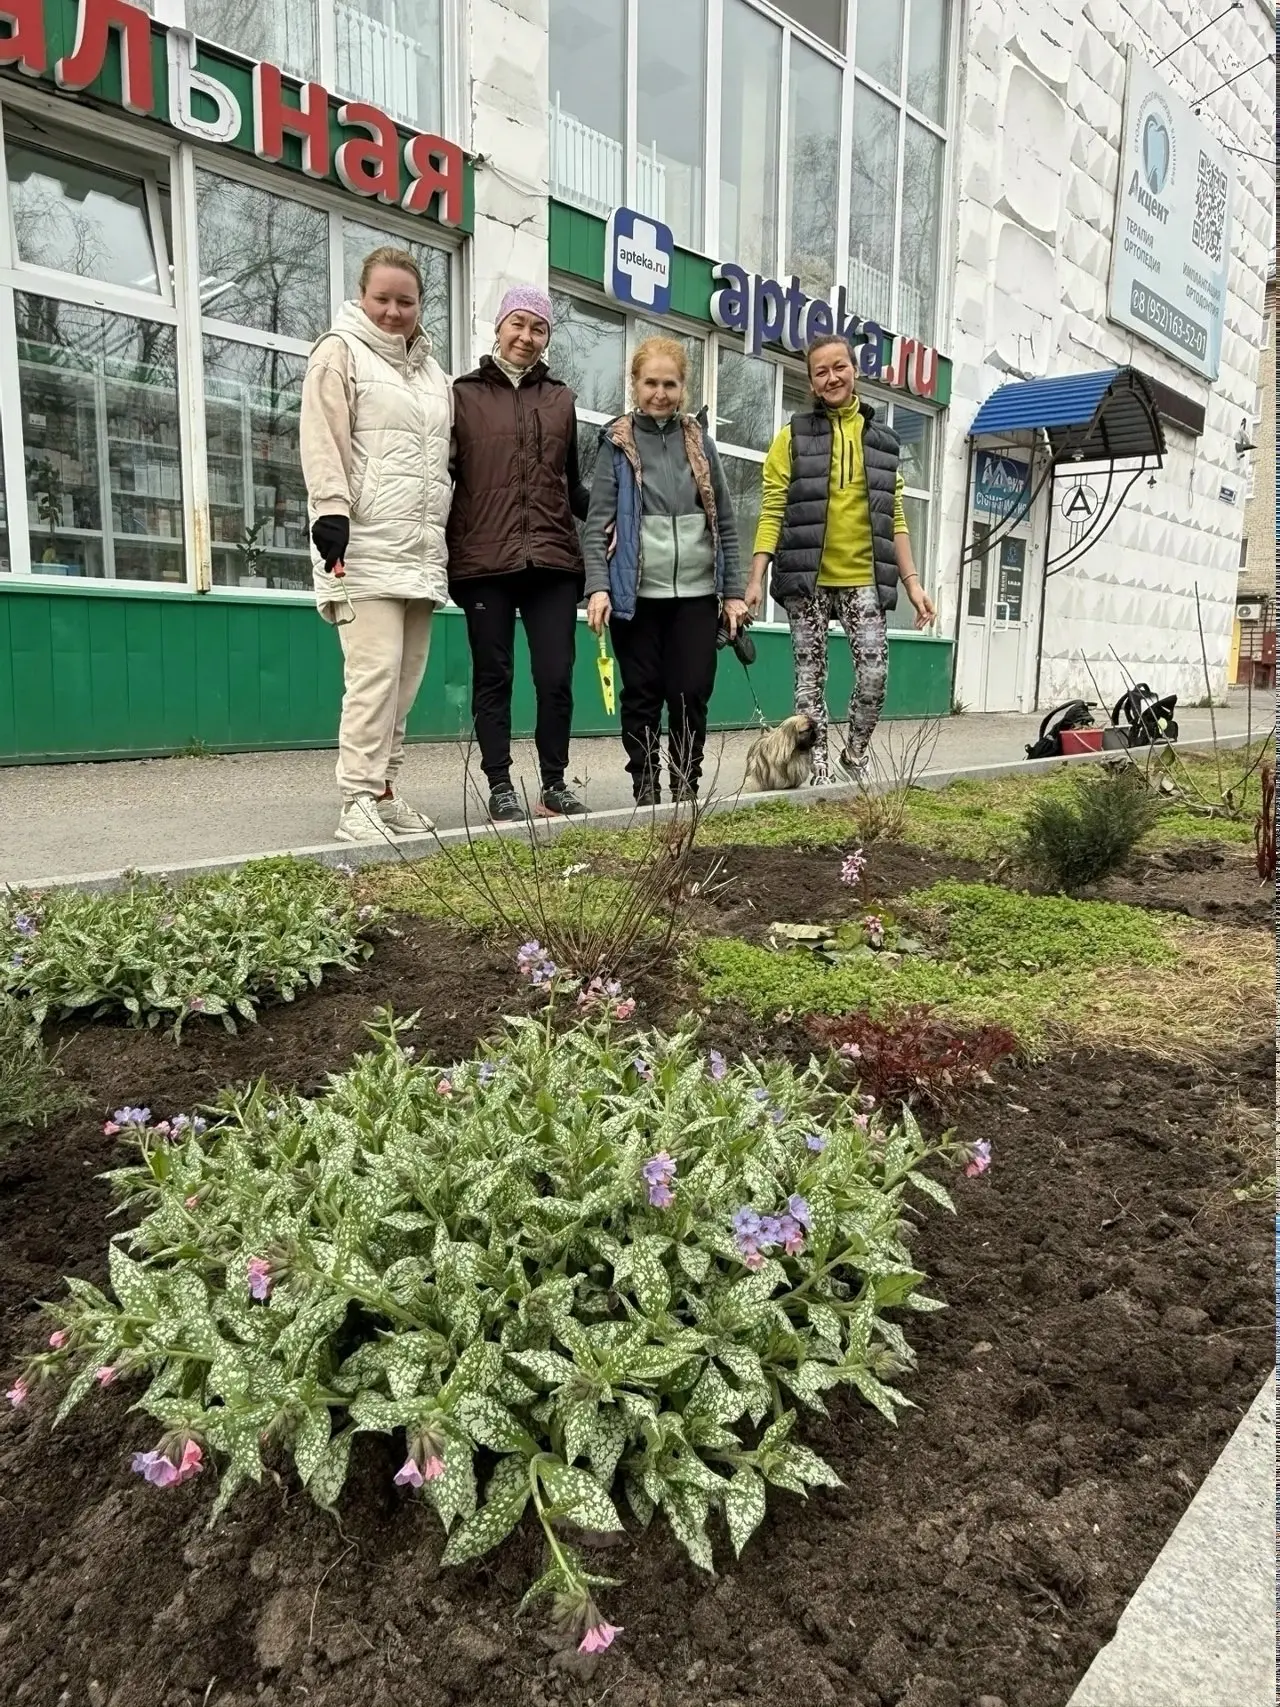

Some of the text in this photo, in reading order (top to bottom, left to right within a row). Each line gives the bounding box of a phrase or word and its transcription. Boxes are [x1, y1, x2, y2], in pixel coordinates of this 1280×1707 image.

[1128, 169, 1170, 225] Акцент
[1126, 216, 1155, 249] ТЕРАПИЯ
[619, 247, 667, 276] apteka.ru
[1124, 237, 1161, 275] ОРТОПЕДИЯ
